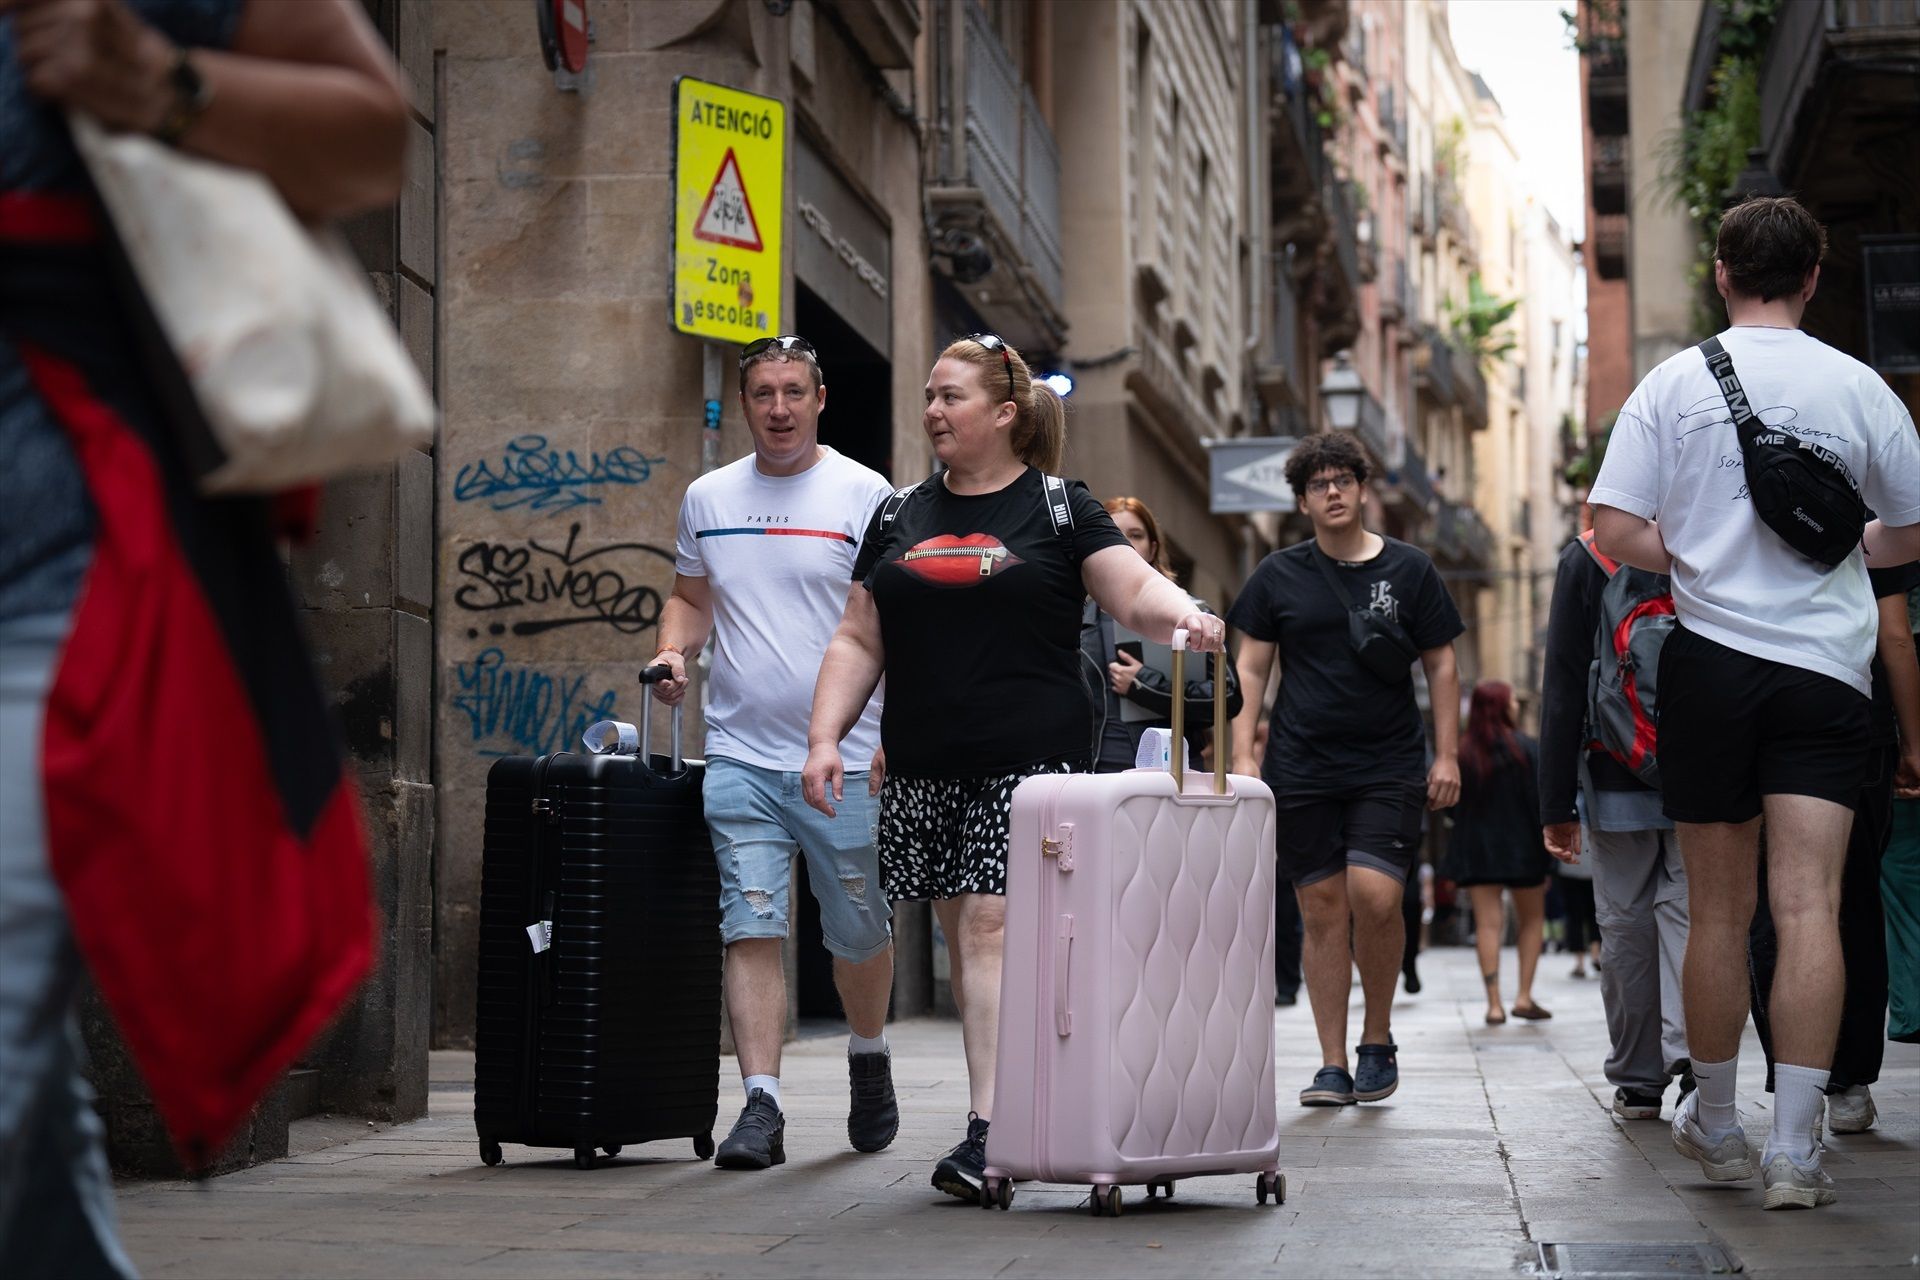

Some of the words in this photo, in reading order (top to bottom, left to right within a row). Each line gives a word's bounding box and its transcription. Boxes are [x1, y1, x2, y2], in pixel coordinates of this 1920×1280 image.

[691, 101, 772, 139] ATENCIÓ
[707, 259, 751, 284] Zona
[747, 515, 789, 523] PARIS
[1793, 507, 1824, 534] Supreme
